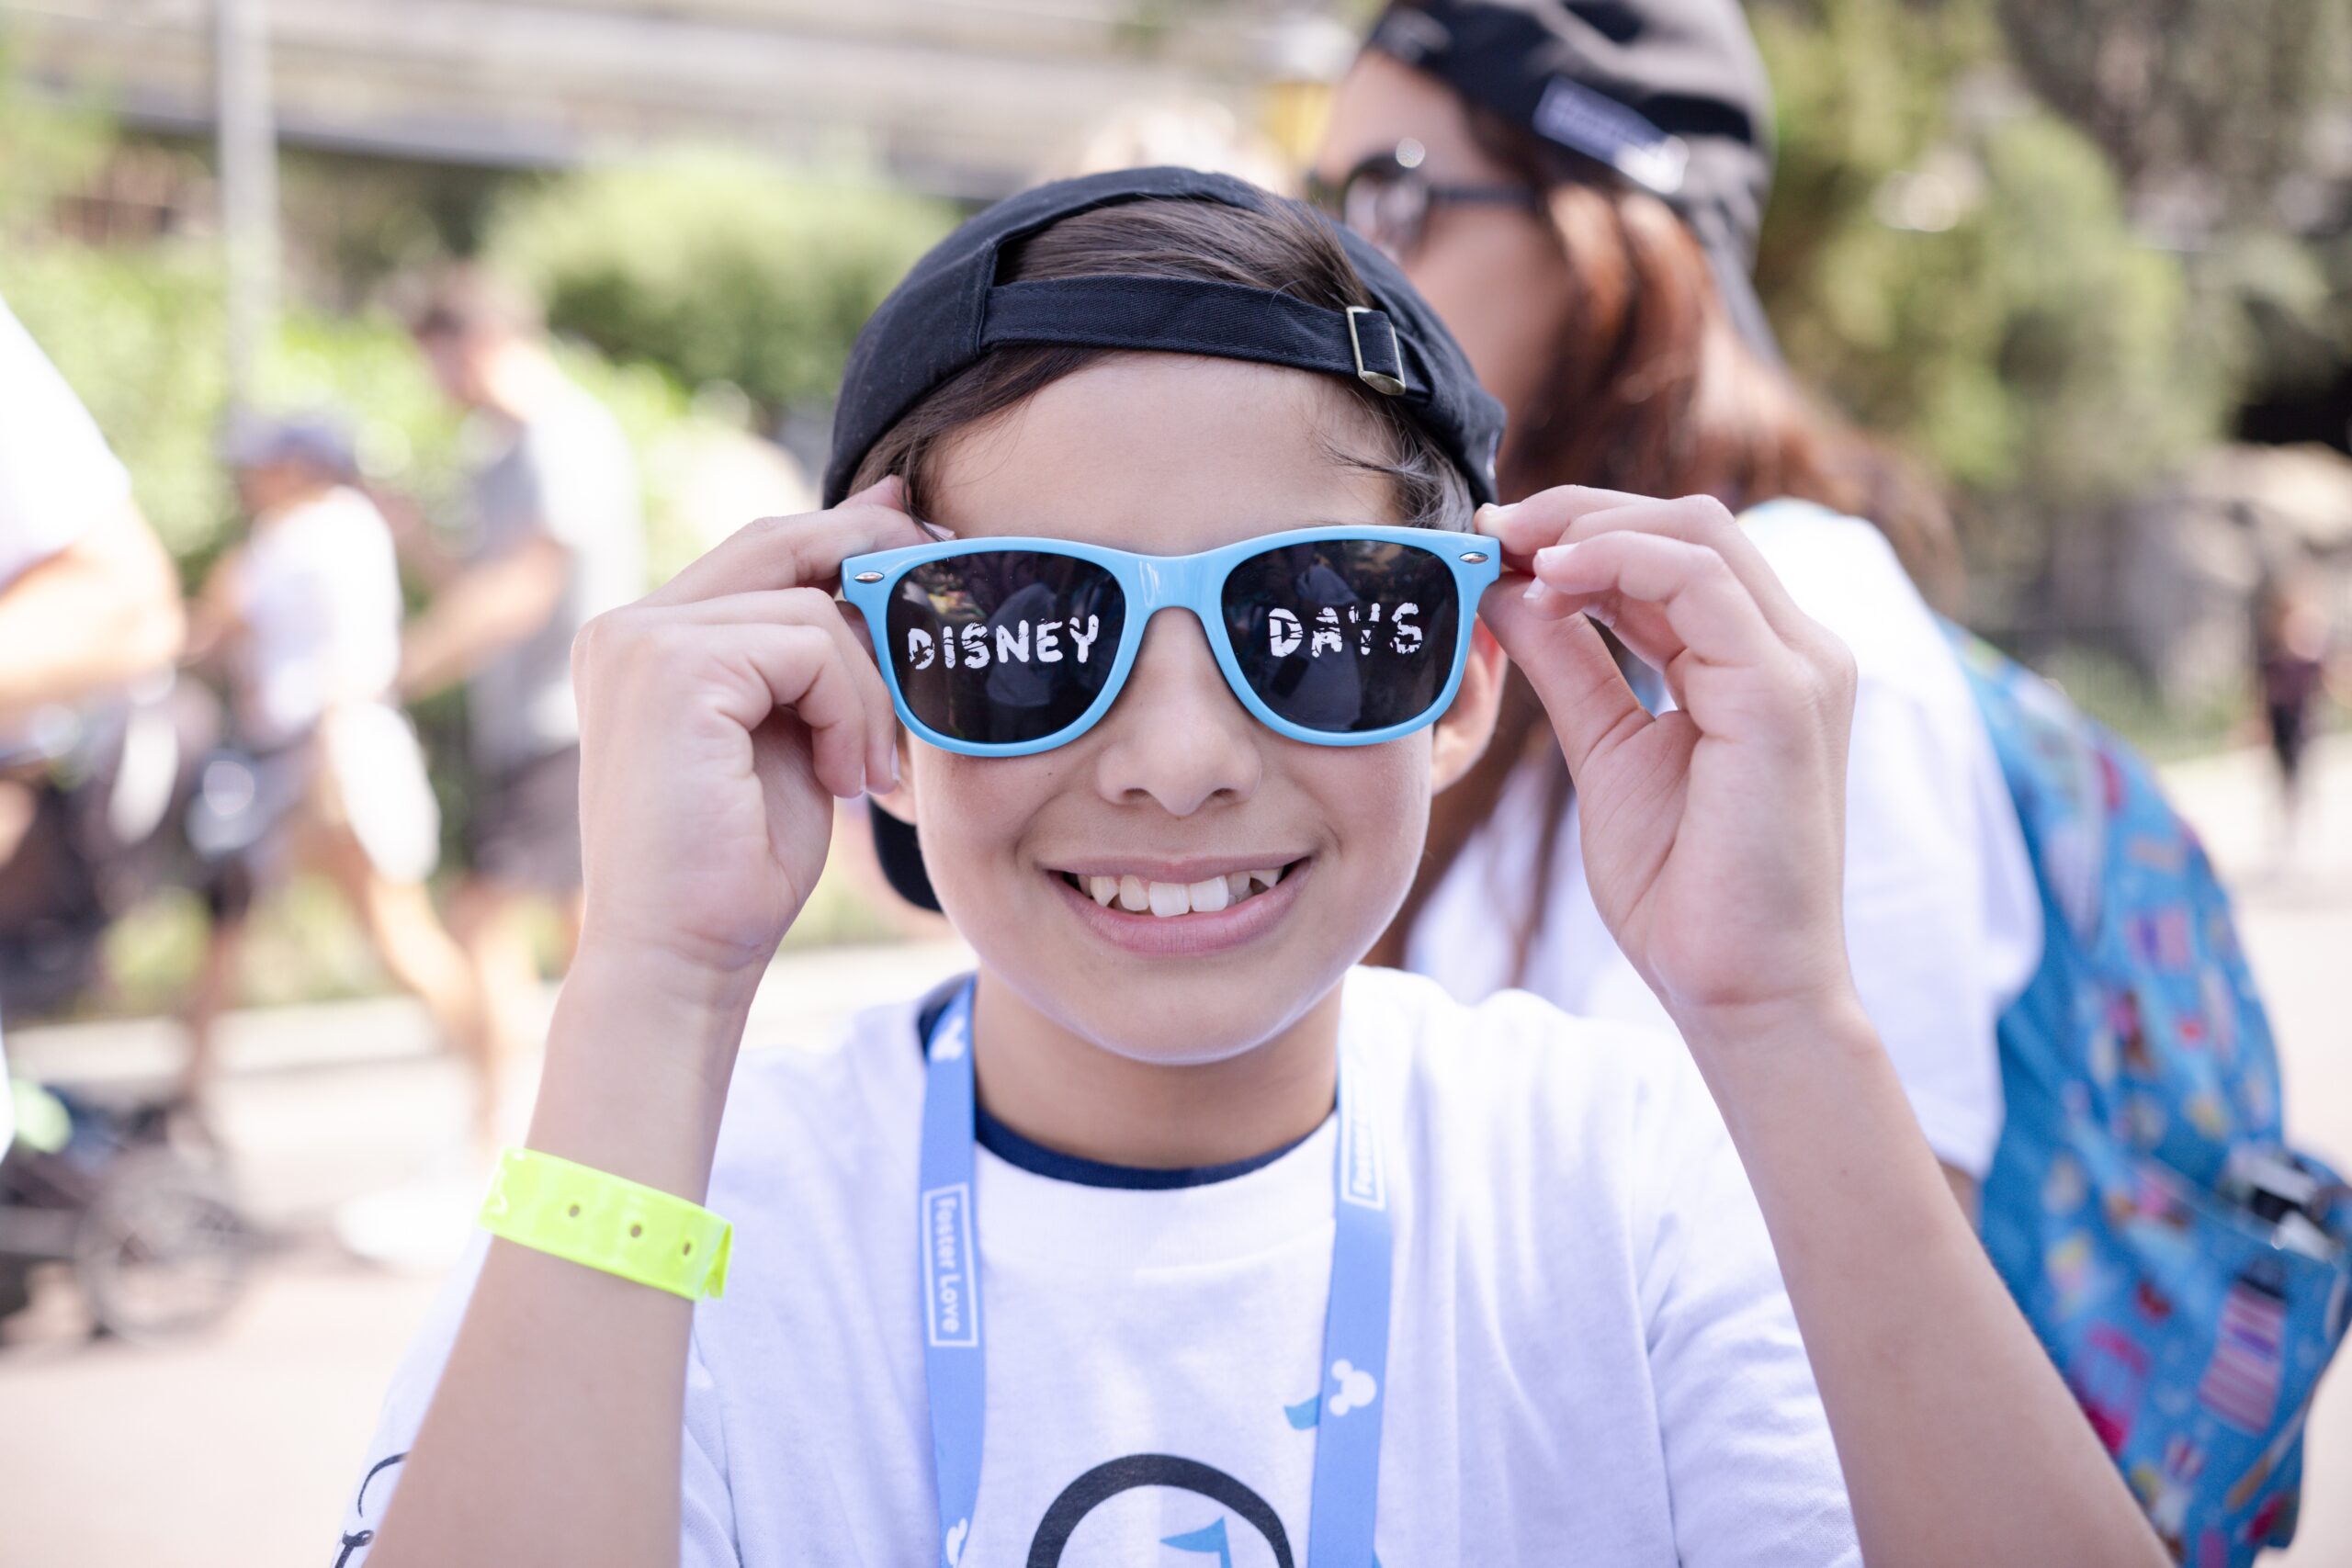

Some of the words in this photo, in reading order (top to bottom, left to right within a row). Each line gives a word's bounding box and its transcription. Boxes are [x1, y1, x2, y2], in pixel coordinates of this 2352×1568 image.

[907, 614, 1100, 670] DISNEY
[1269, 603, 1424, 658] DAYS
[939, 1274, 962, 1334] Love
